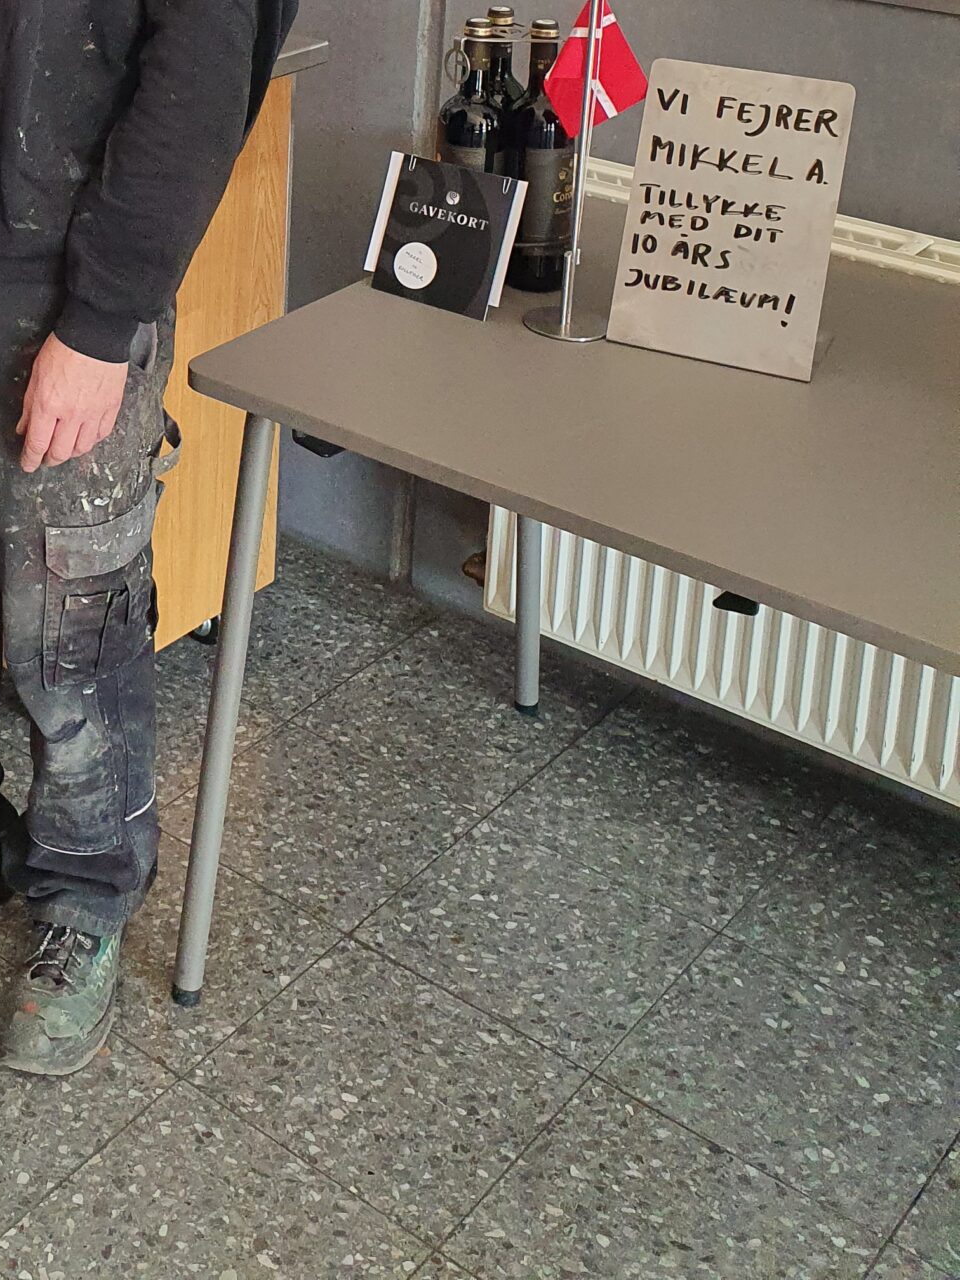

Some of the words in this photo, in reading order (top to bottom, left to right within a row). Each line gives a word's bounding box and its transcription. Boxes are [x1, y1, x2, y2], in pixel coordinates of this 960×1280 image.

[656, 87, 690, 116] VI
[716, 96, 839, 138] FEJRER
[649, 134, 793, 181] MIKKEL
[805, 158, 829, 185] A.
[409, 201, 489, 231] GAVEKORT
[639, 183, 787, 221] TILLYKKE
[640, 210, 710, 232] MED
[733, 223, 784, 243] DIT
[630, 232, 658, 255] 10
[671, 232, 732, 269] ÅRS
[624, 268, 796, 328] JUBILÆUM!
